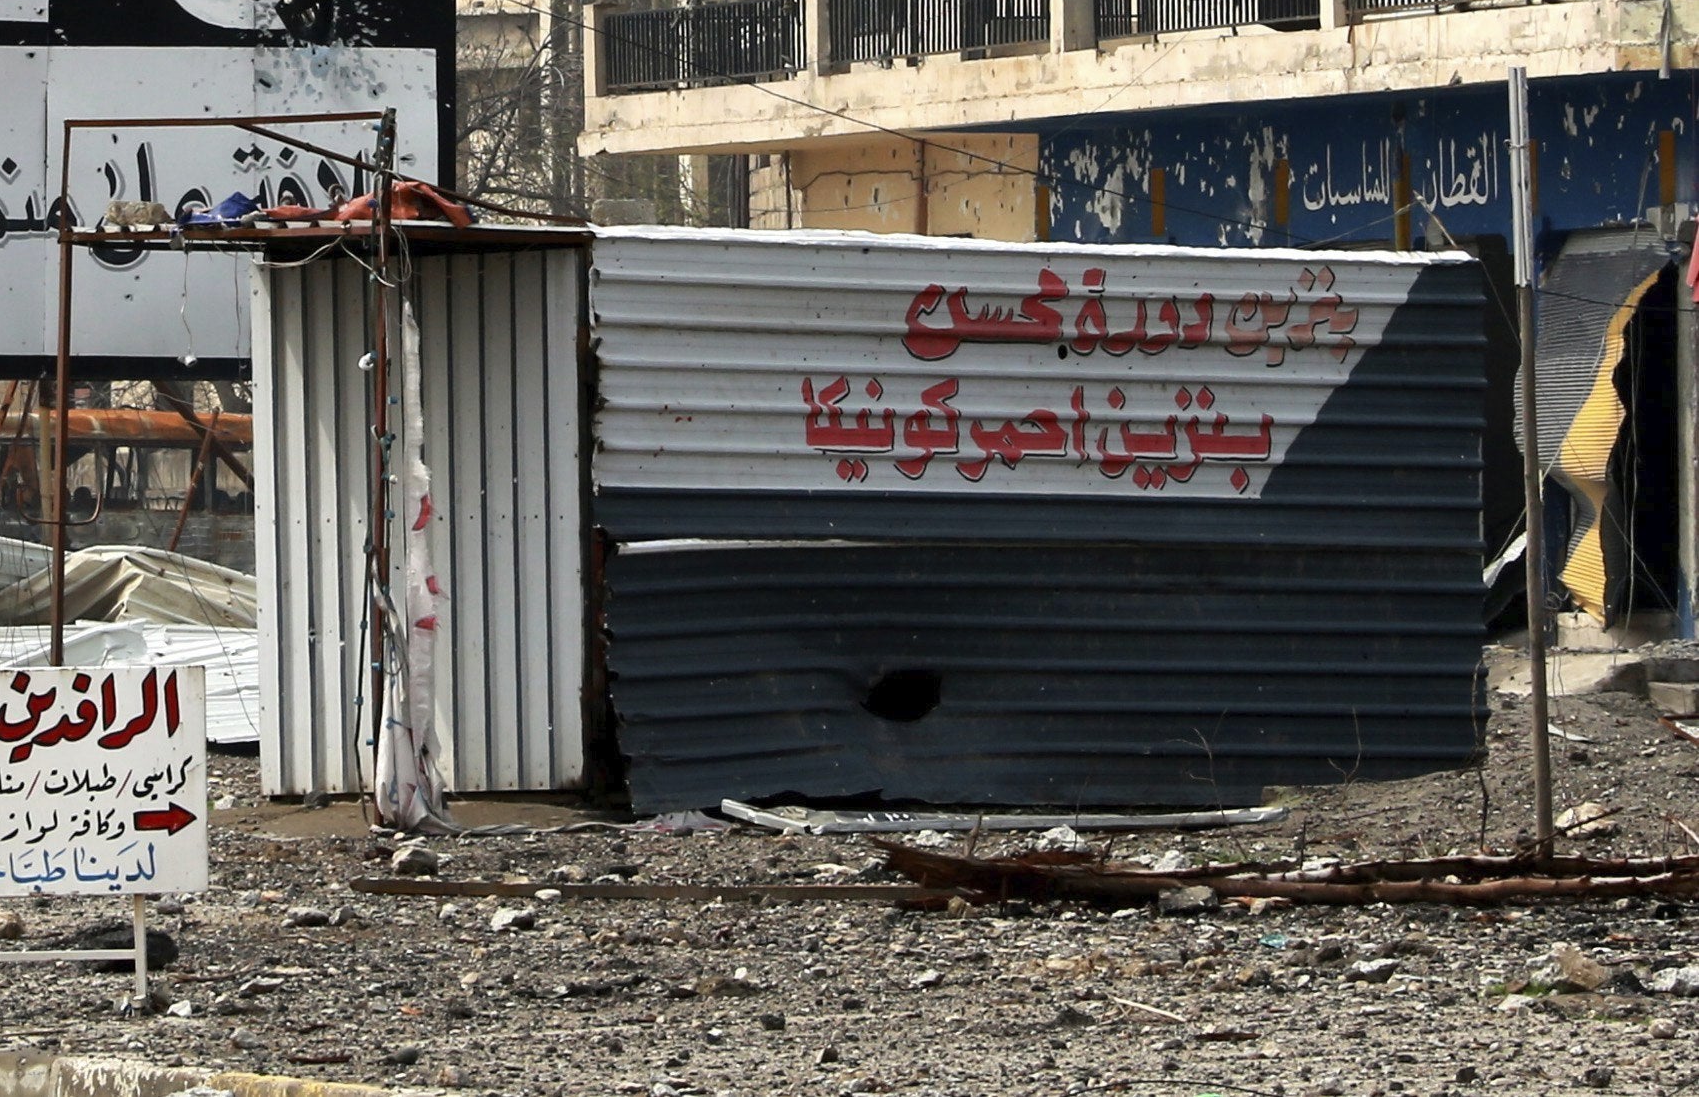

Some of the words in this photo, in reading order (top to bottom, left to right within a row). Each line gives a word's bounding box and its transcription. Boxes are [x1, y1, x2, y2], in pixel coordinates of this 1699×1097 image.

[1303, 136, 1391, 224] للمناسبات
[1421, 130, 1498, 213] القطان
[1097, 385, 1275, 495] بنزين
